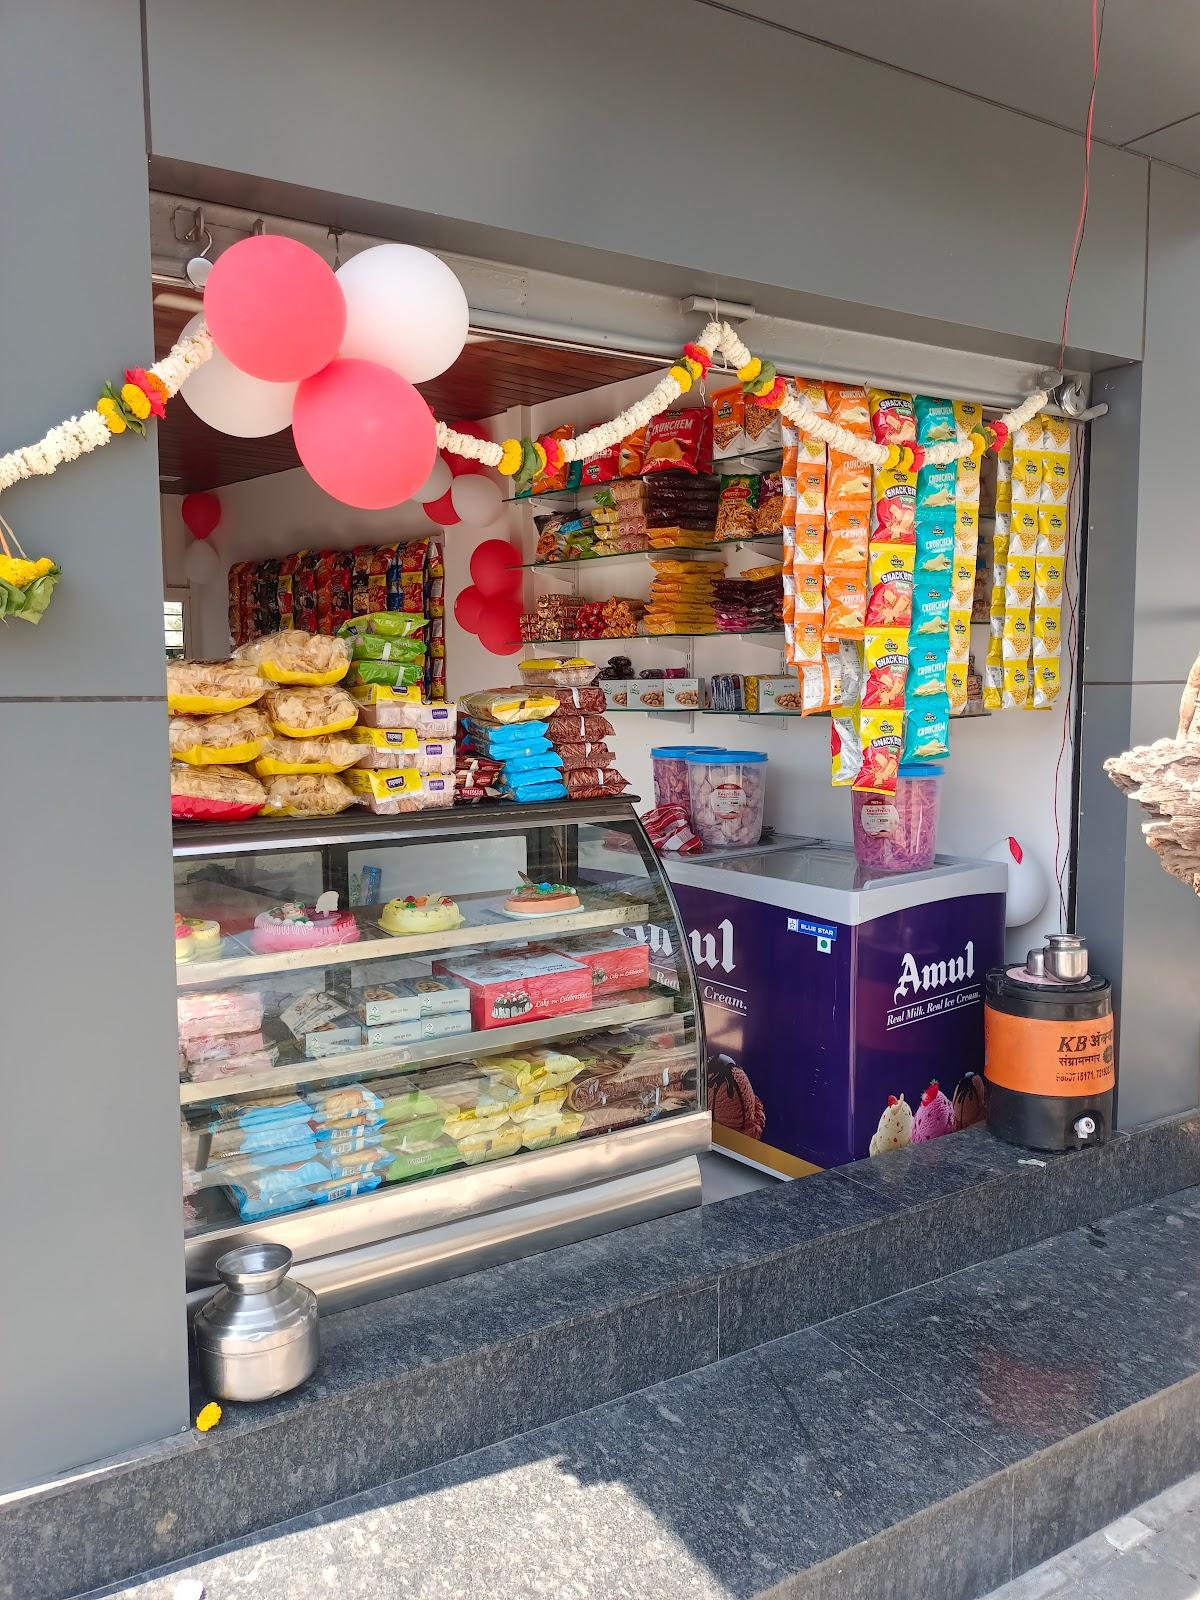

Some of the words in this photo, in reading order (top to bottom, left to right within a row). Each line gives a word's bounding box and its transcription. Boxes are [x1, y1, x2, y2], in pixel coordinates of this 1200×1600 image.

[876, 656, 909, 668] SNACK'em
[917, 662, 947, 676] CRUNCHEM
[917, 722, 946, 737] CRUNCHEM
[801, 924, 817, 932] BLUE
[818, 928, 834, 936] STAR
[893, 940, 975, 1005] Amul
[704, 985, 748, 1010] Cream.
[886, 1011, 904, 1027] Real
[905, 1005, 926, 1021] Milk.
[926, 999, 944, 1014] Real
[944, 997, 955, 1008] Ice
[956, 991, 981, 1004] Cream.
[1057, 1036, 1088, 1052] KB
